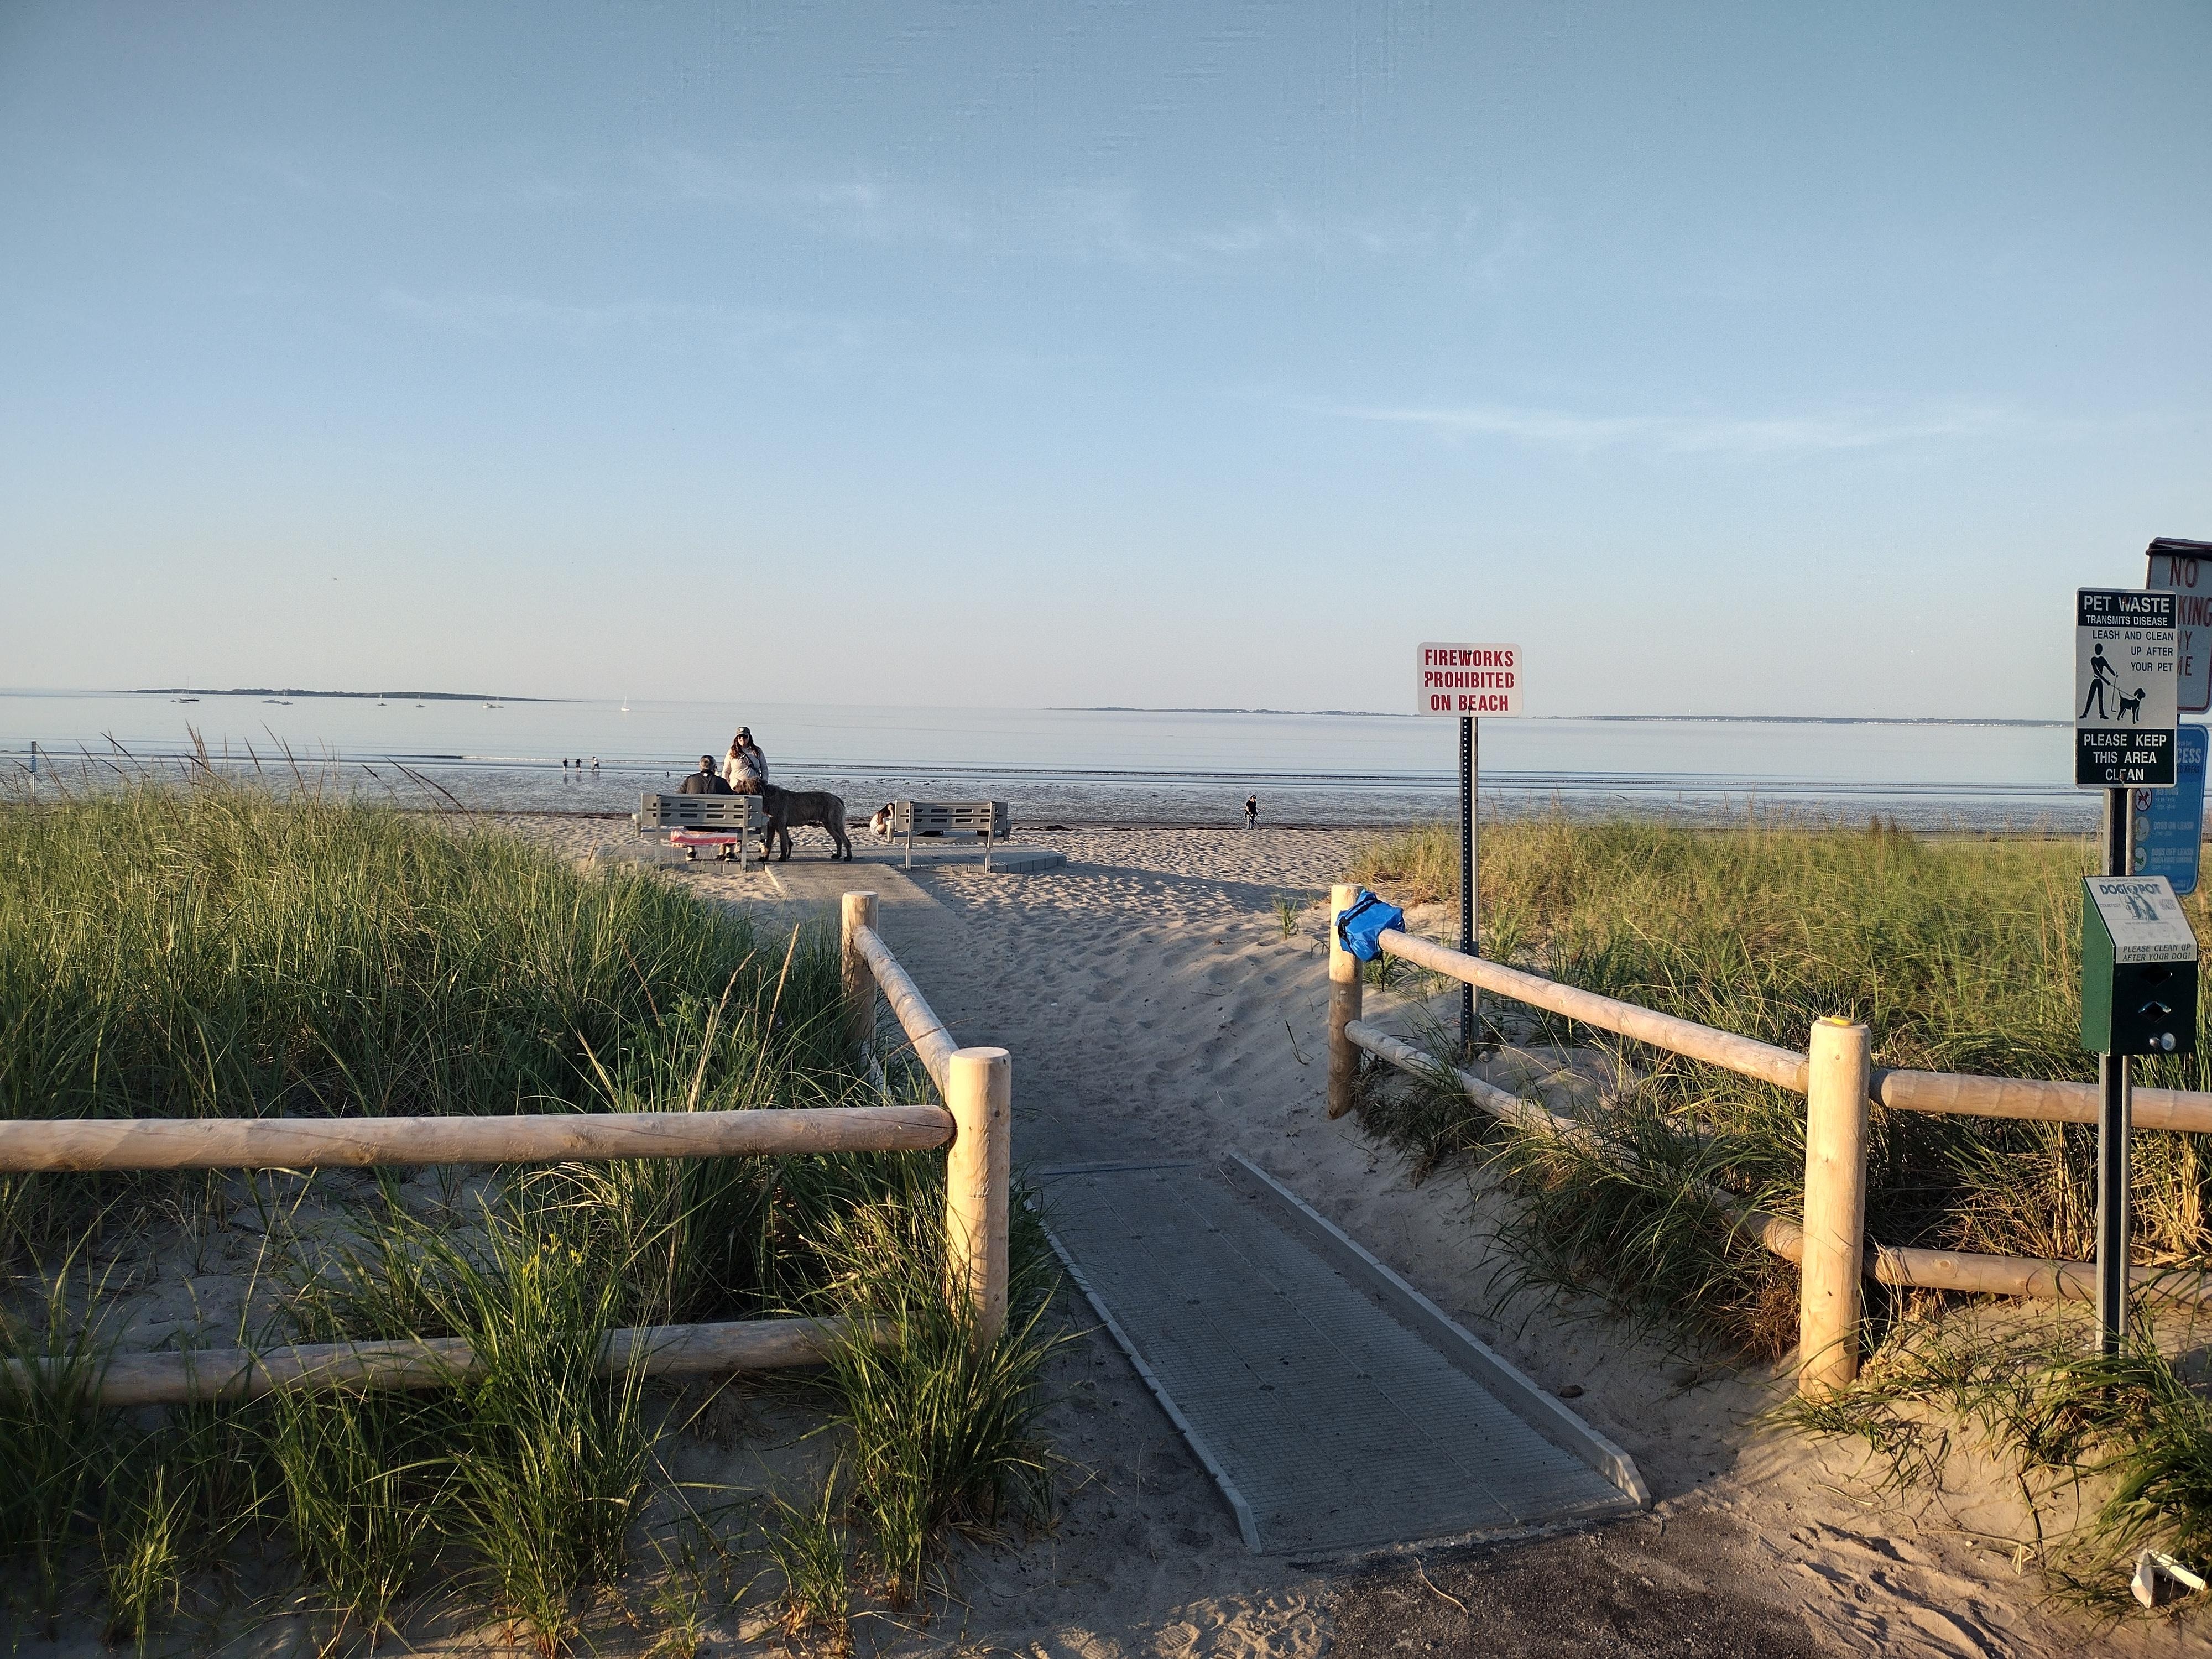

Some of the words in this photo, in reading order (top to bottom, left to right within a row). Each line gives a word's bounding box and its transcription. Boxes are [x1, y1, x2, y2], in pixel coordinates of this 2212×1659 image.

[2169, 556, 2199, 588] NO
[2084, 596, 2111, 611] PET
[2118, 597, 2170, 613] WASTE
[2178, 596, 2212, 627] KING
[2086, 615, 2131, 625] TRANSMITS
[2133, 617, 2168, 626] DISEASE
[2093, 630, 2120, 640] LEASH
[2125, 631, 2141, 640] AND
[2146, 632, 2173, 641] CLEAN
[1425, 649, 1514, 667] FIREWORKS
[2131, 646, 2142, 655] UP
[2146, 647, 2173, 656] AFTER
[2131, 662, 2152, 671] YOUR
[2158, 663, 2173, 671] PET
[1424, 671, 1514, 688] PROHIBITED
[1431, 694, 1451, 711] ON
[1458, 695, 1509, 711] BEACH
[2084, 734, 2127, 746] PLEASE
[2136, 734, 2167, 747] KEEP
[2093, 752, 2118, 763] THIS
[2124, 752, 2157, 764] AREA
[2177, 748, 2201, 764] CESS
